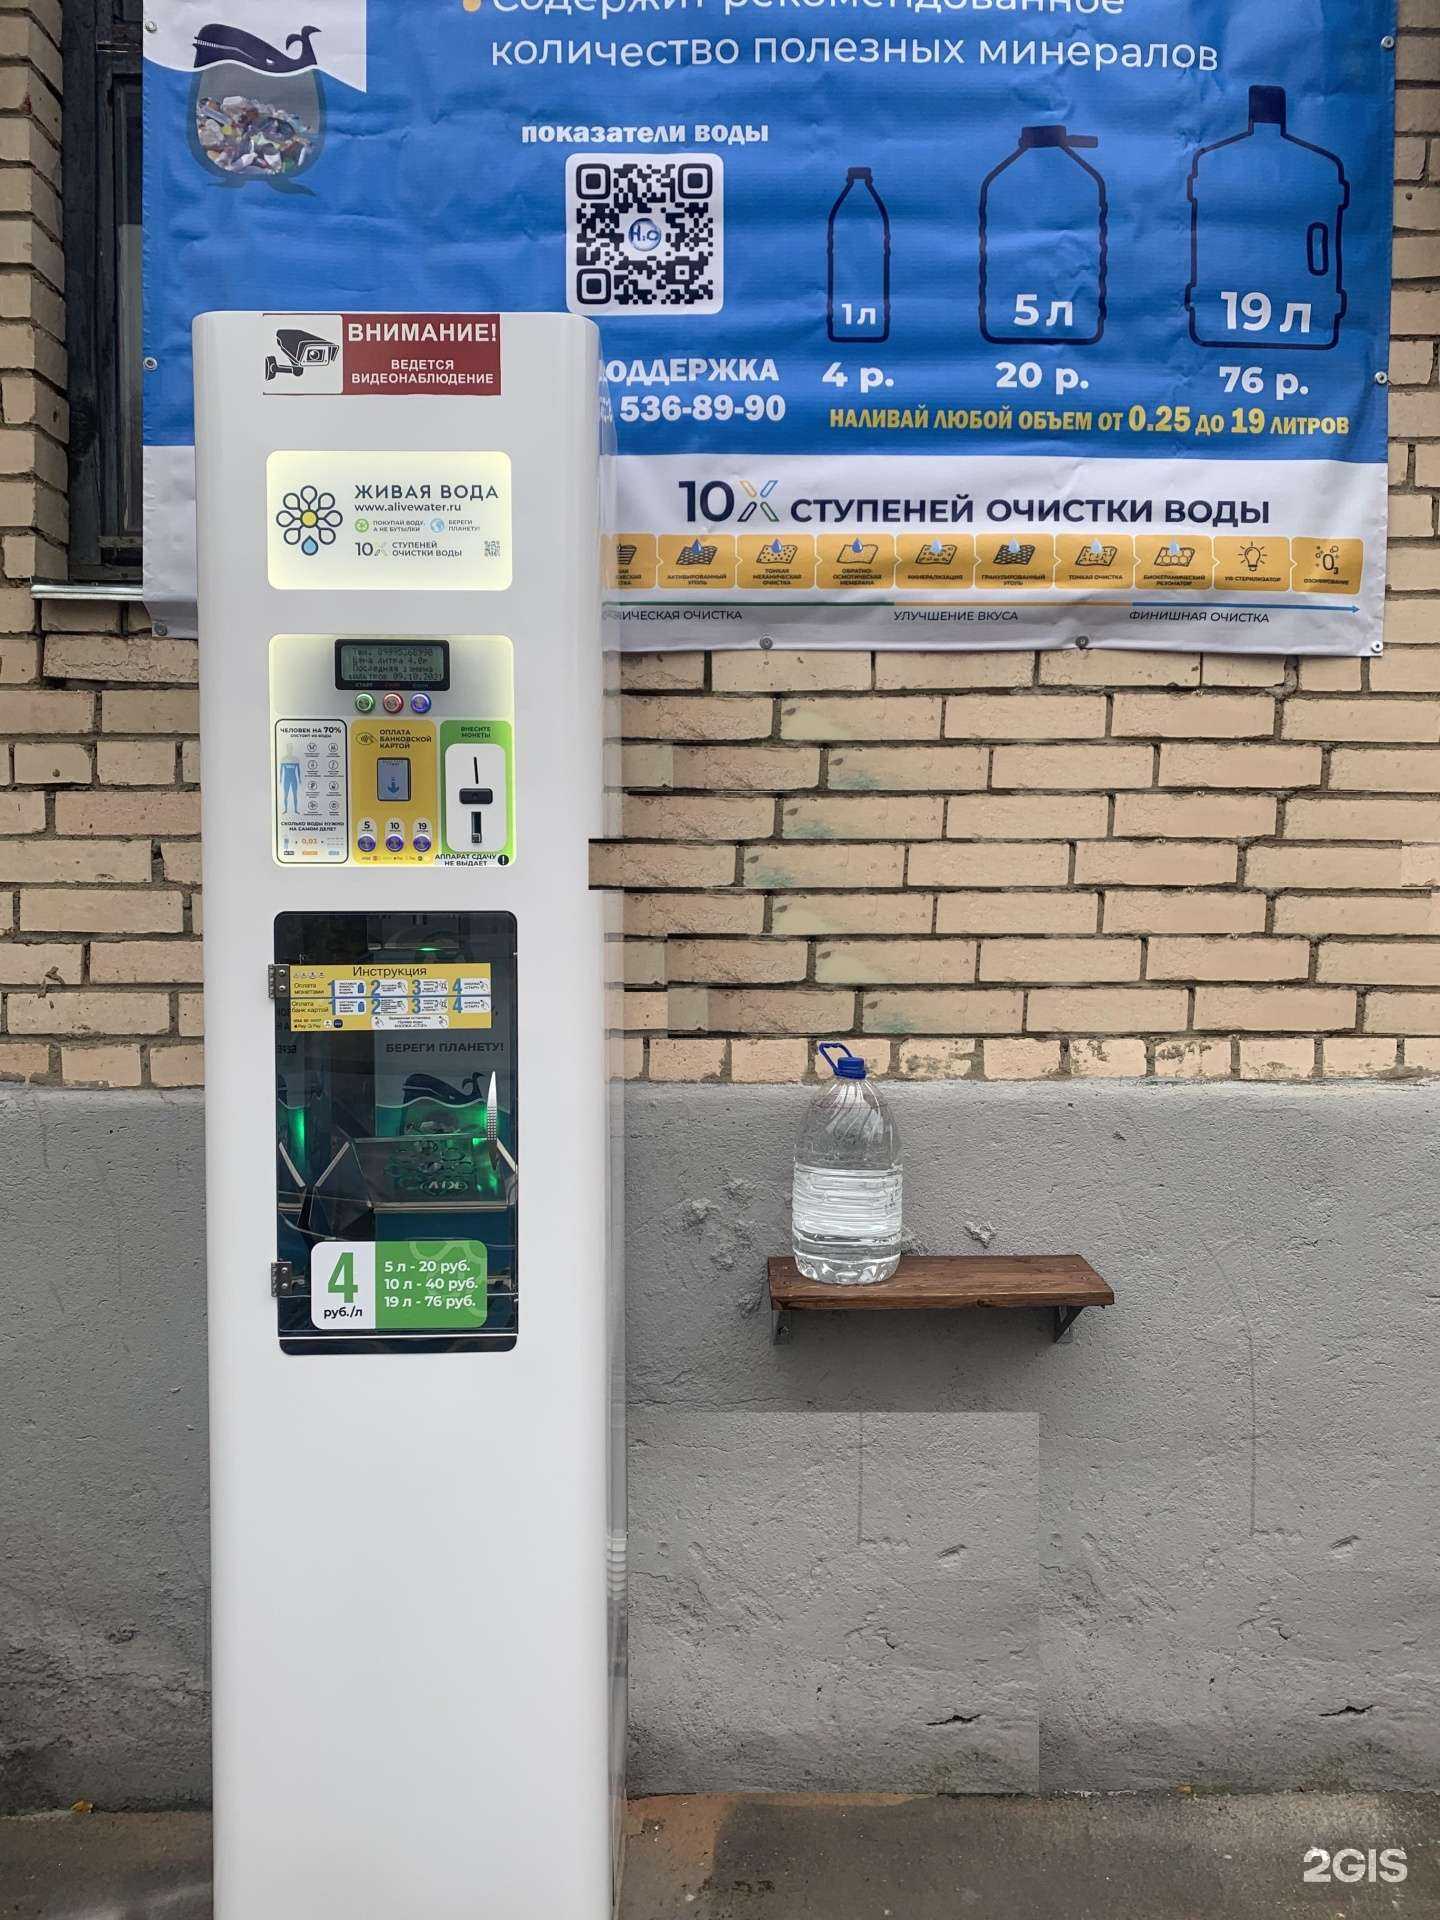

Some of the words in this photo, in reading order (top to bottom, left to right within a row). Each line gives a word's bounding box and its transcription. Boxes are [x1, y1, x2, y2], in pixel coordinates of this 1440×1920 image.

[491, 38, 740, 67] количество
[754, 36, 965, 65] полезных
[978, 38, 1219, 71] минералов
[521, 124, 686, 144] показатели
[694, 124, 769, 146] воды
[1220, 291, 1272, 332] 19
[348, 322, 497, 342] ВНИМАНИЕ!
[391, 359, 454, 371] ВЕДЕТСЯ
[604, 358, 780, 387] ОДДЕРЖКА
[822, 361, 848, 388] 4
[860, 367, 895, 393] р.
[995, 361, 1043, 389] 20
[1055, 367, 1089, 395] р.
[351, 373, 494, 386] ВИДЕОНАБЛЮДЕНИЕ
[1219, 366, 1264, 394] 76
[1275, 372, 1309, 401] р.
[619, 394, 787, 422] 536-89-90
[829, 404, 929, 429] НАЛИВАЙ
[933, 404, 1013, 430] ЛЮБОЙ
[1018, 410, 1092, 431] ОБЪЕМ
[1097, 411, 1124, 432] ОТ
[1128, 404, 1191, 433] 0.25
[1195, 414, 1225, 437] ДО
[1230, 407, 1266, 434] 19
[1269, 416, 1350, 436] ЛИТРОВ
[354, 484, 431, 499] ЖИВАЯ
[440, 484, 499, 502] ВОДА
[354, 502, 462, 512] www.alivewater.ru
[789, 493, 974, 523] СТУПЕНЕЙ
[986, 499, 1153, 523] ОЧИСТКИ
[1164, 500, 1270, 528] ВОДЫ
[392, 541, 438, 549] СТУПЕНЕЙ
[392, 549, 434, 557] ОЧИСТКИ
[435, 549, 462, 558] ВОДЫ
[620, 609, 680, 621] ИЧЕСКАЯ
[683, 609, 743, 621] ОЧИСТКА
[894, 610, 976, 621] УЛУЧШЕНИЕ
[977, 611, 1019, 621] ВКУСА
[1129, 610, 1206, 622] ФИНИШНАЯ
[1210, 611, 1270, 623] ОЧИСТКА
[323, 726, 342, 734] 70%
[379, 735, 432, 743] БАНКОВСКОЙ
[364, 821, 370, 829] 5
[390, 822, 400, 830] 10
[418, 822, 428, 830] 19
[353, 966, 427, 978] Инструкция
[386, 1042, 436, 1053] БЕРЕГИ
[438, 1042, 504, 1053] ПЛАНЕТУ!
[384, 1261, 393, 1273] 5
[396, 1263, 406, 1272] л
[418, 1260, 437, 1272] 20
[440, 1260, 471, 1274] руб.
[327, 1251, 359, 1304] 4
[384, 1278, 400, 1290] 10
[402, 1281, 413, 1290] л
[425, 1278, 445, 1290] 40
[448, 1278, 478, 1292] руб.
[384, 1296, 399, 1308] 19
[402, 1298, 412, 1308] л
[424, 1296, 443, 1308] 76
[445, 1296, 476, 1310] руб.
[323, 1306, 363, 1319] руб./л
